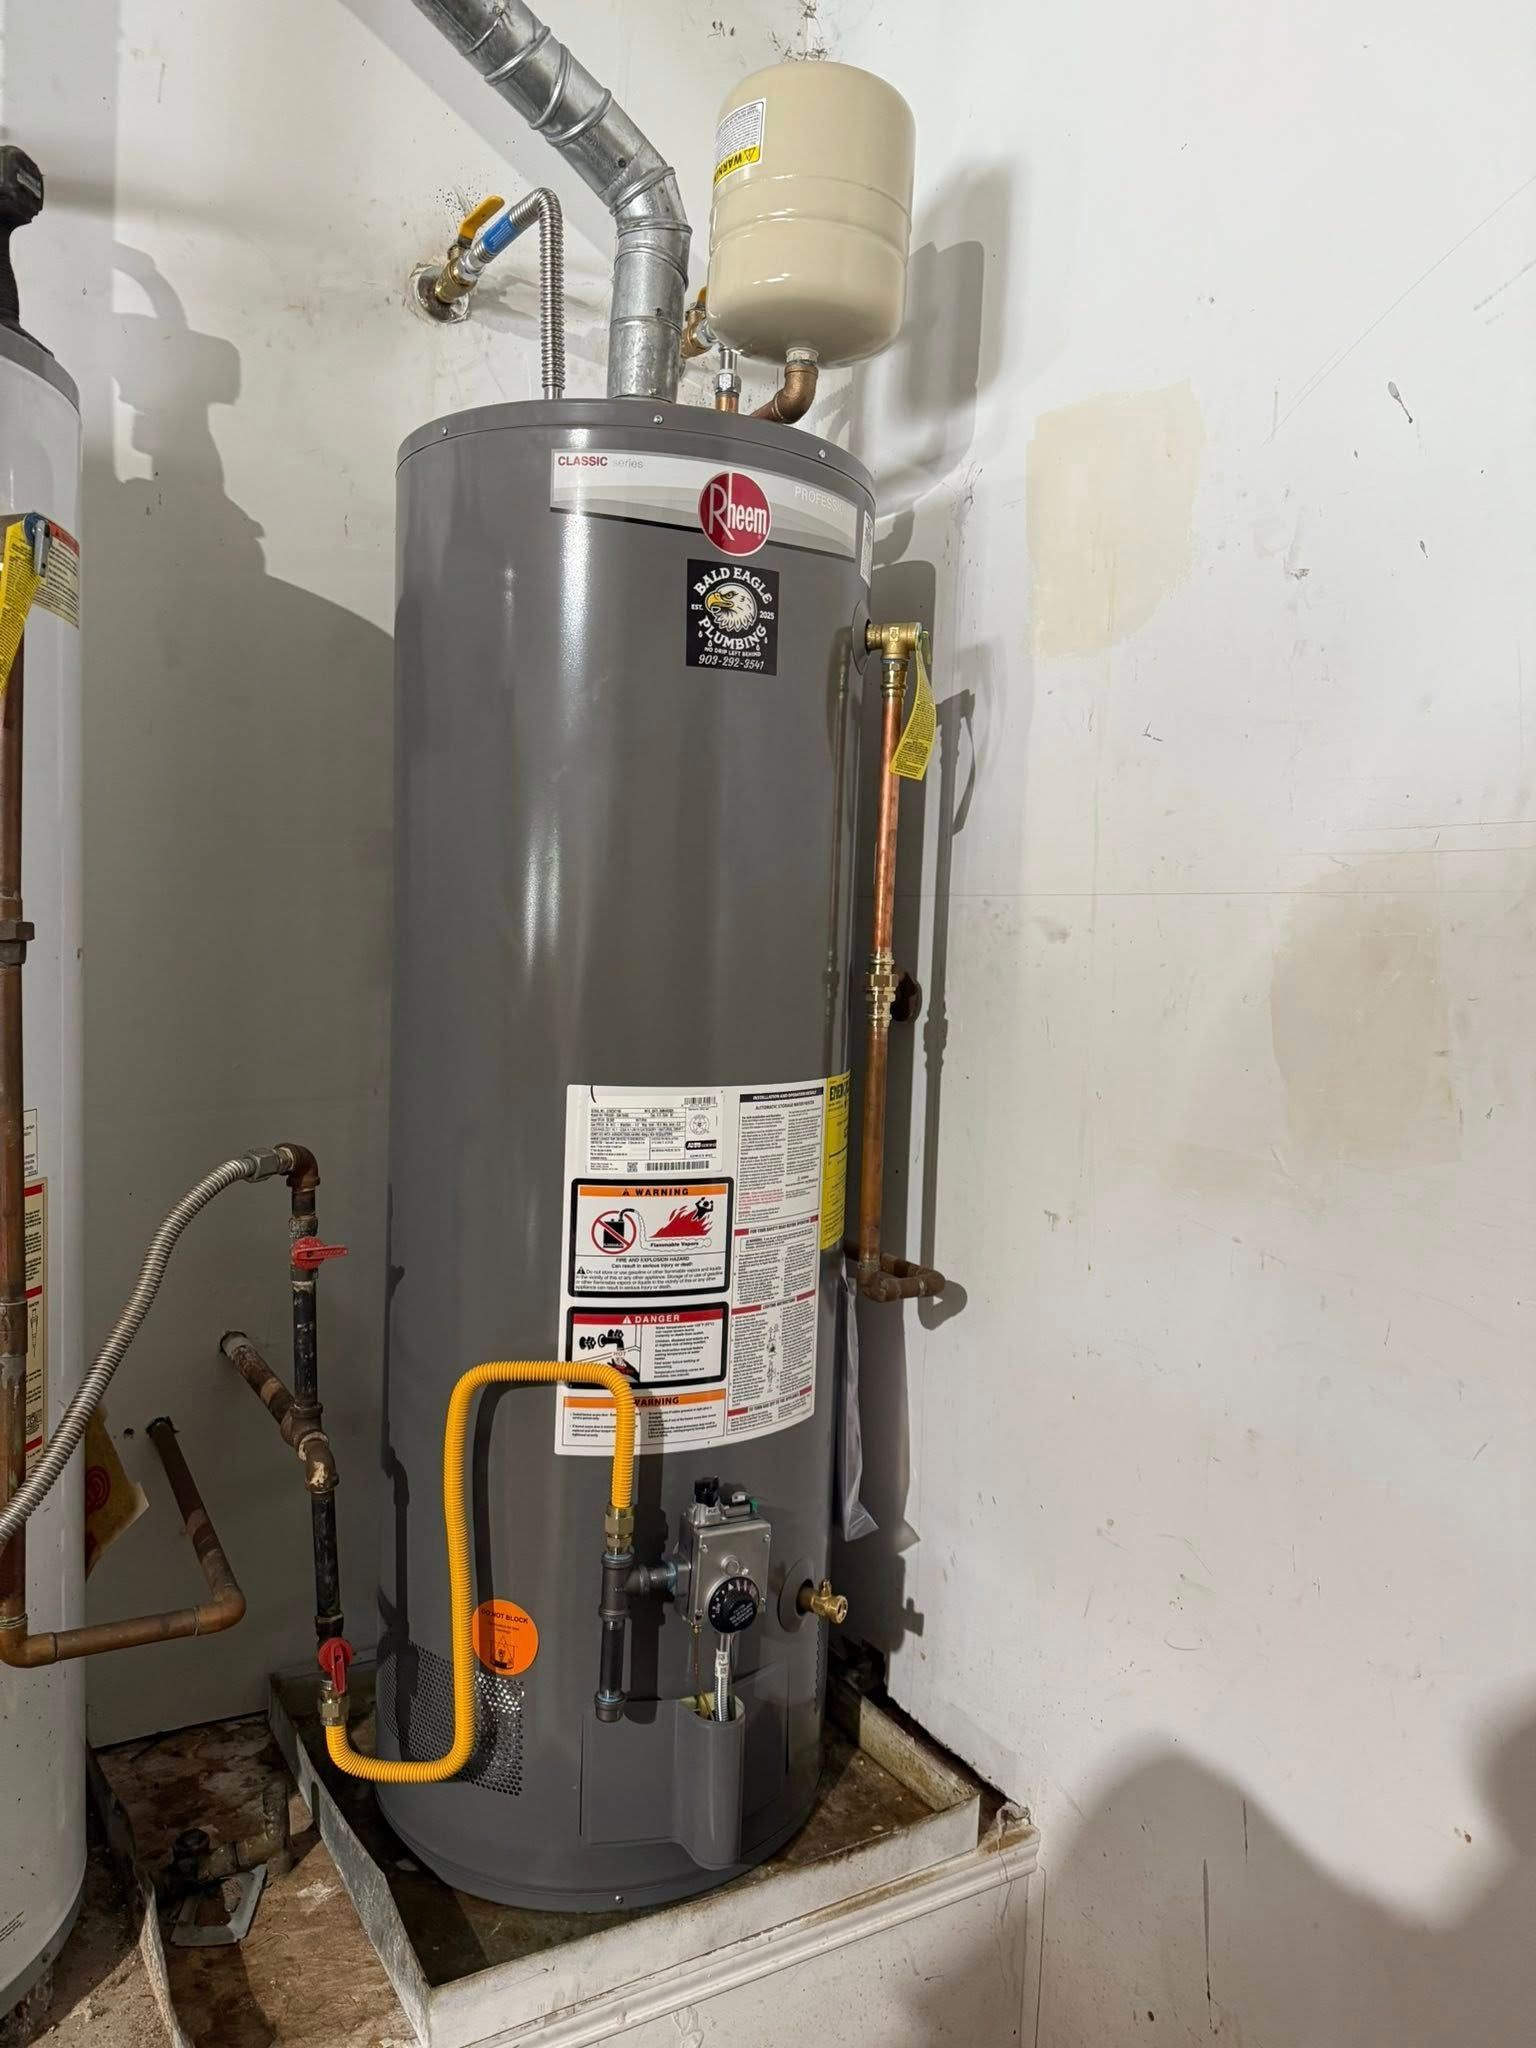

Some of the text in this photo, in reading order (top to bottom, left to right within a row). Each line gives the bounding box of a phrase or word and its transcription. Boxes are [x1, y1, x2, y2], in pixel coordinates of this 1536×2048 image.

[713, 152, 742, 182] WARN
[558, 456, 608, 466] CLASSIC
[707, 472, 768, 541] Rheem
[693, 567, 773, 604] BALD EAGLE
[760, 610, 774, 620] 2025
[698, 615, 767, 650] PLUMBING
[698, 654, 764, 670] 903-292-3541
[636, 1188, 688, 1196] WARNING
[634, 1314, 680, 1324] DANGER
[506, 1614, 528, 1624] BLOCK
